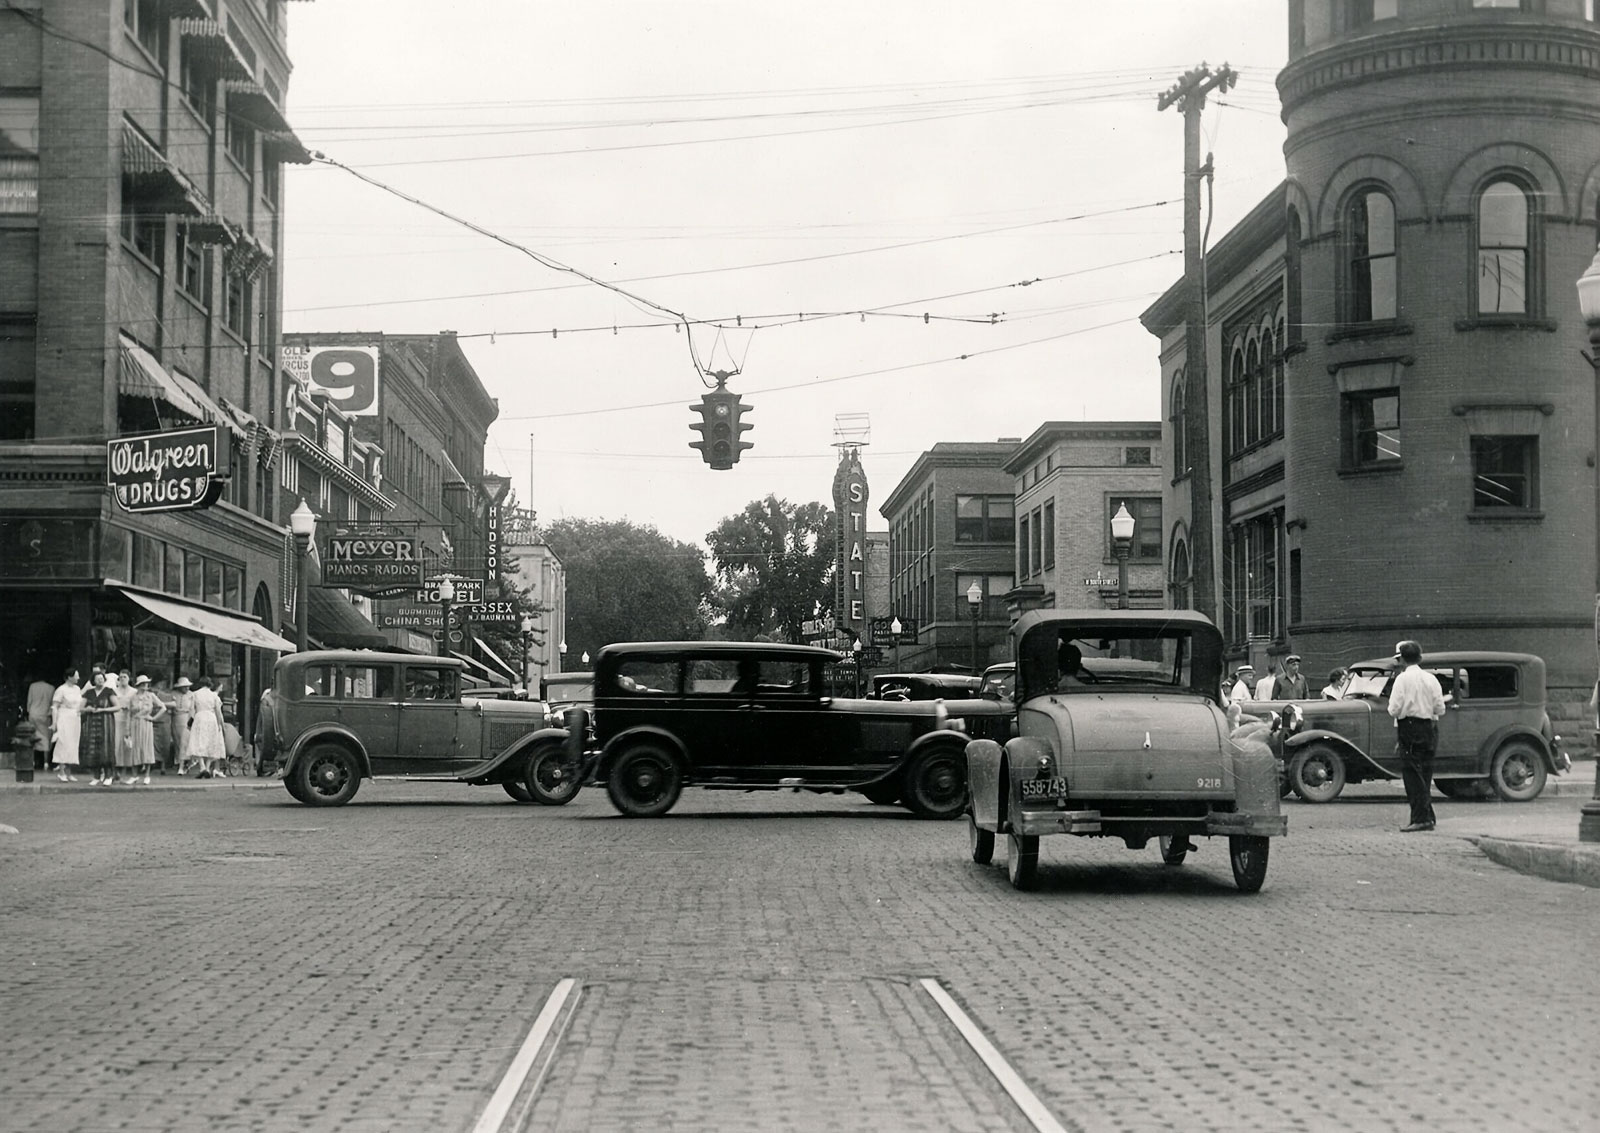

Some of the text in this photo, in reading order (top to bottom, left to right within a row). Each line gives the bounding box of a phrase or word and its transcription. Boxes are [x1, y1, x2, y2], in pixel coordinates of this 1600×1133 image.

[311, 350, 374, 411] 9
[111, 440, 211, 481] Walgreen
[131, 478, 192, 504] DRUGS
[488, 507, 497, 580] HUDSON
[850, 483, 863, 620] STATE
[327, 564, 419, 575] PIANOS RADIOS
[417, 590, 480, 602] HOEL
[471, 602, 513, 613] ESSEX
[384, 617, 420, 625] CHINA
[1197, 778, 1221, 788] 9218
